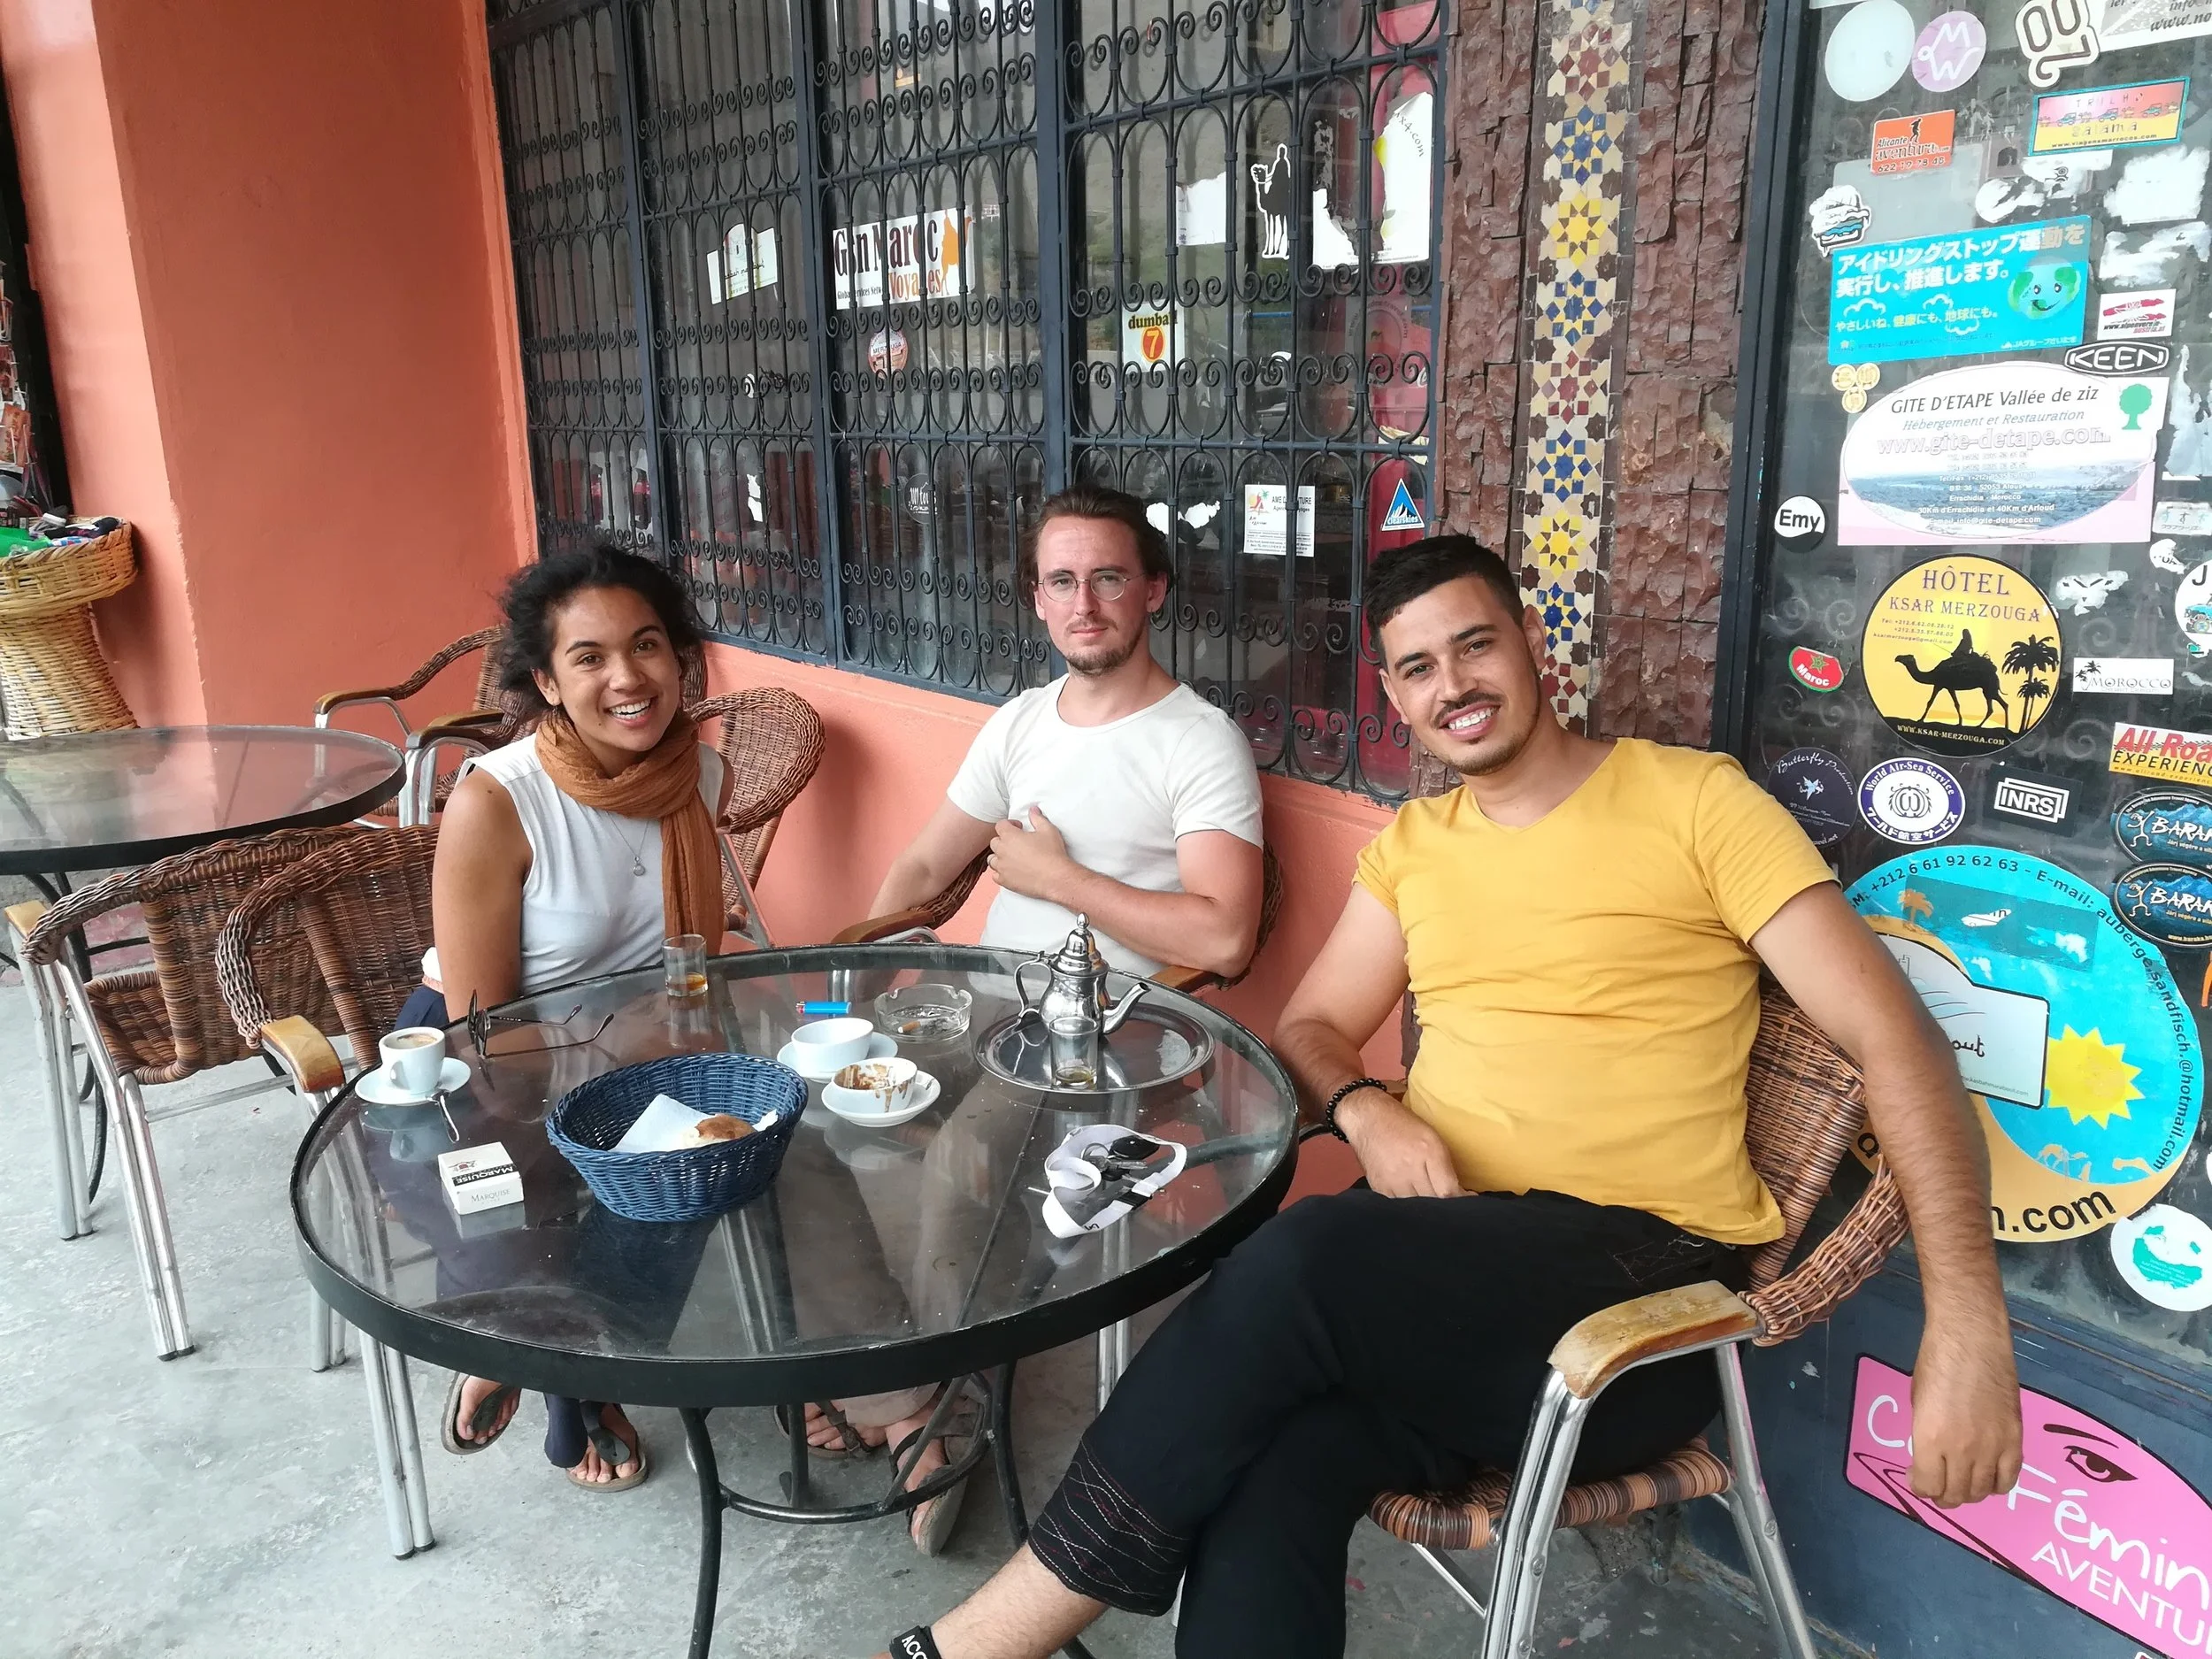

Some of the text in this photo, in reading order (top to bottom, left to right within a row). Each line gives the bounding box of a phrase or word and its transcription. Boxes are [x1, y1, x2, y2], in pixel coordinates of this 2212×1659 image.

[1877, 136, 1908, 148] Alicante
[1878, 163, 1897, 173] 622
[1838, 224, 2085, 275] アイドリングストップ運動を
[887, 269, 941, 301] Voyaes
[1835, 259, 2008, 298] 実行し、推進します。
[2070, 347, 2164, 370] KEEN
[1891, 386, 2099, 414] GITE D'ETAPE Vallée de ziz
[1902, 410, 2085, 432] Hébergement et Restauration
[1779, 509, 1821, 532] Emy
[1923, 565, 2010, 595] HÔTEL
[1889, 596, 2040, 622] KSAR MERZOUGA
[1796, 664, 1830, 686] Maroc
[2091, 678, 2171, 688] MOROCCO
[1897, 725, 2005, 746] WWW.KSAR-MERZOUGA.COM
[2114, 727, 2157, 754] All
[1777, 752, 1824, 774] Butterfly
[1825, 760, 1854, 795] Production
[1865, 767, 1888, 791] World
[1925, 765, 1955, 795] Service
[2000, 787, 2055, 816] INRS
[1867, 807, 1959, 841] ワールド航空サービス
[1871, 867, 1906, 892] +212
[1909, 863, 1918, 874] 6
[1923, 857, 1941, 871] 61
[1946, 855, 1967, 866] 92
[1971, 855, 1992, 866] 62
[1998, 859, 2019, 872] 63
[2036, 869, 2095, 909] E-mail:
[456, 1166, 513, 1184] MARQUISE
[2032, 1541, 2212, 1655] AVENTU
